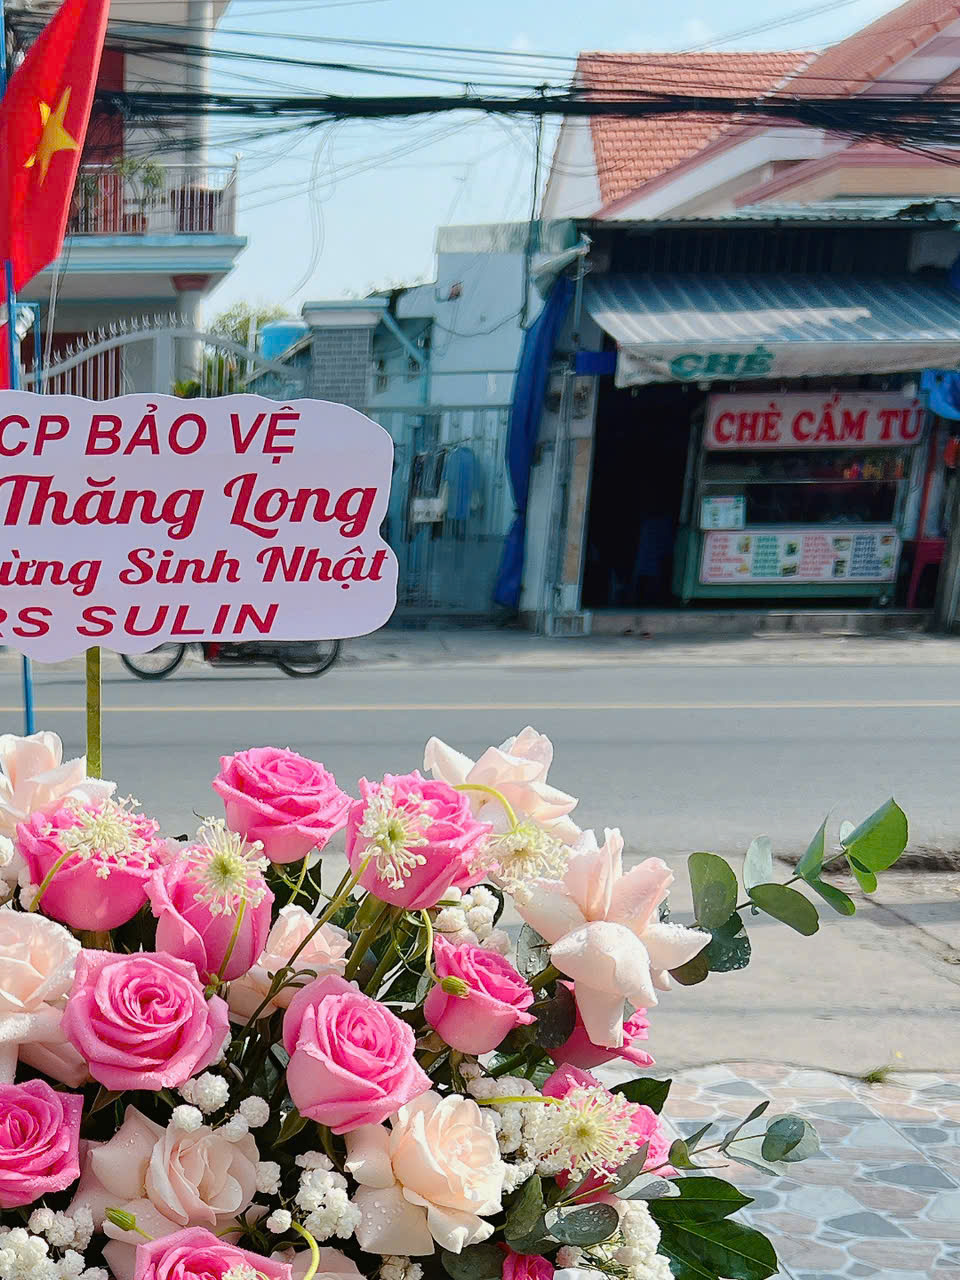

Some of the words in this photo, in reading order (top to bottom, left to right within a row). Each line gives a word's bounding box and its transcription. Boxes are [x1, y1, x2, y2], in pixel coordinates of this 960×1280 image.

[86, 403, 208, 457] BẢO
[231, 405, 301, 465] VỆ
[223, 472, 378, 540] Long
[119, 548, 241, 585] Sinh
[257, 546, 389, 590] Nhật
[77, 602, 280, 637] SULIN
